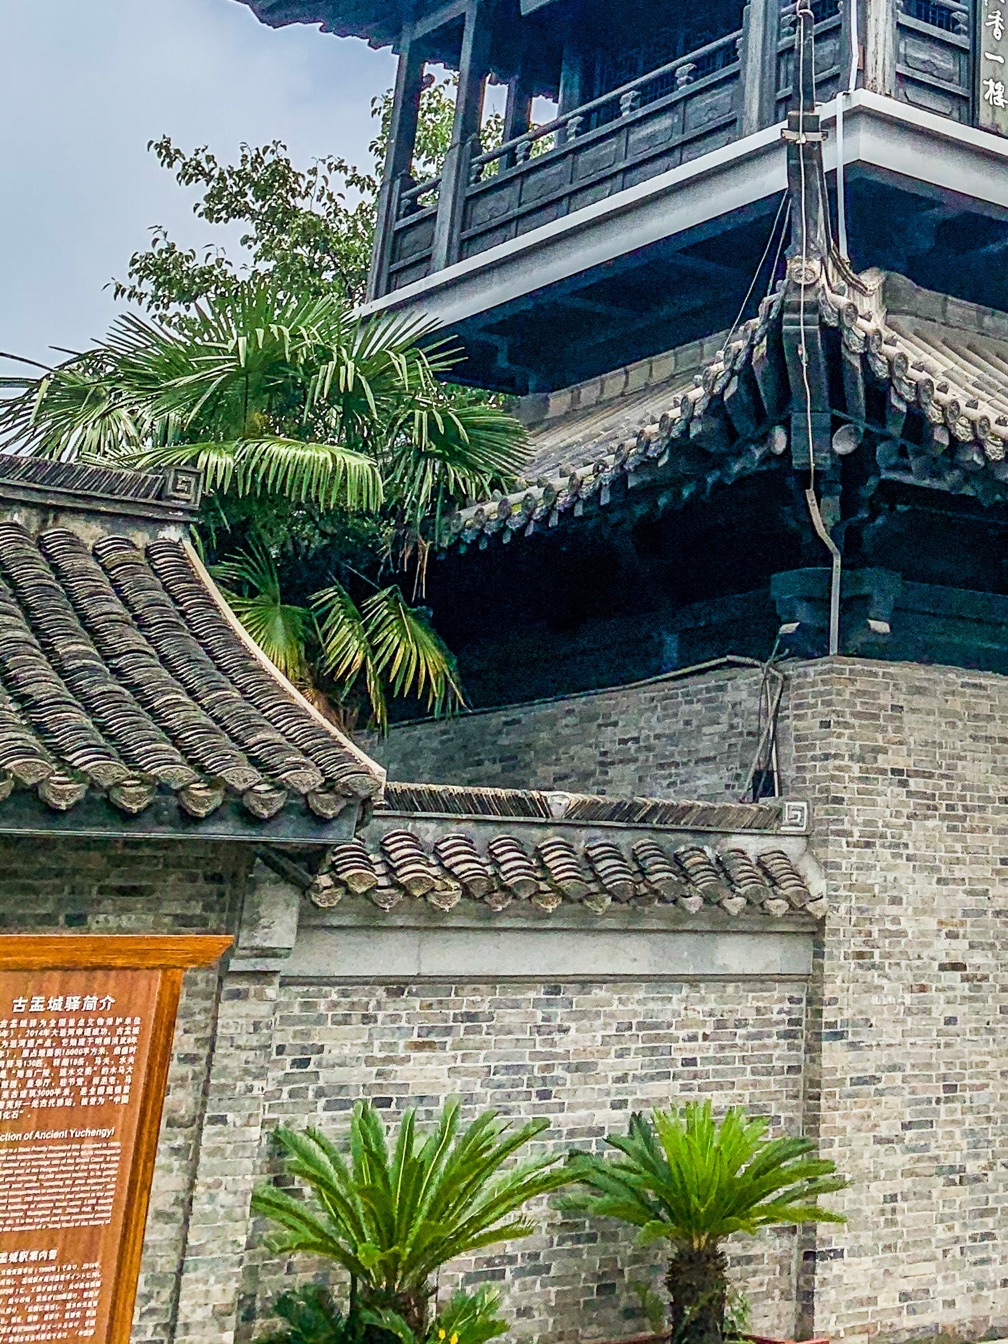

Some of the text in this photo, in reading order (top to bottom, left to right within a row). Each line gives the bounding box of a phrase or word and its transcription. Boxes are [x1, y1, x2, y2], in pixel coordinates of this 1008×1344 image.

[12, 995, 115, 1013] 古盂城驿简介
[23, 1131, 35, 1140] of
[34, 1129, 67, 1140] Ancient
[69, 1126, 115, 1139] Yuchengyi
